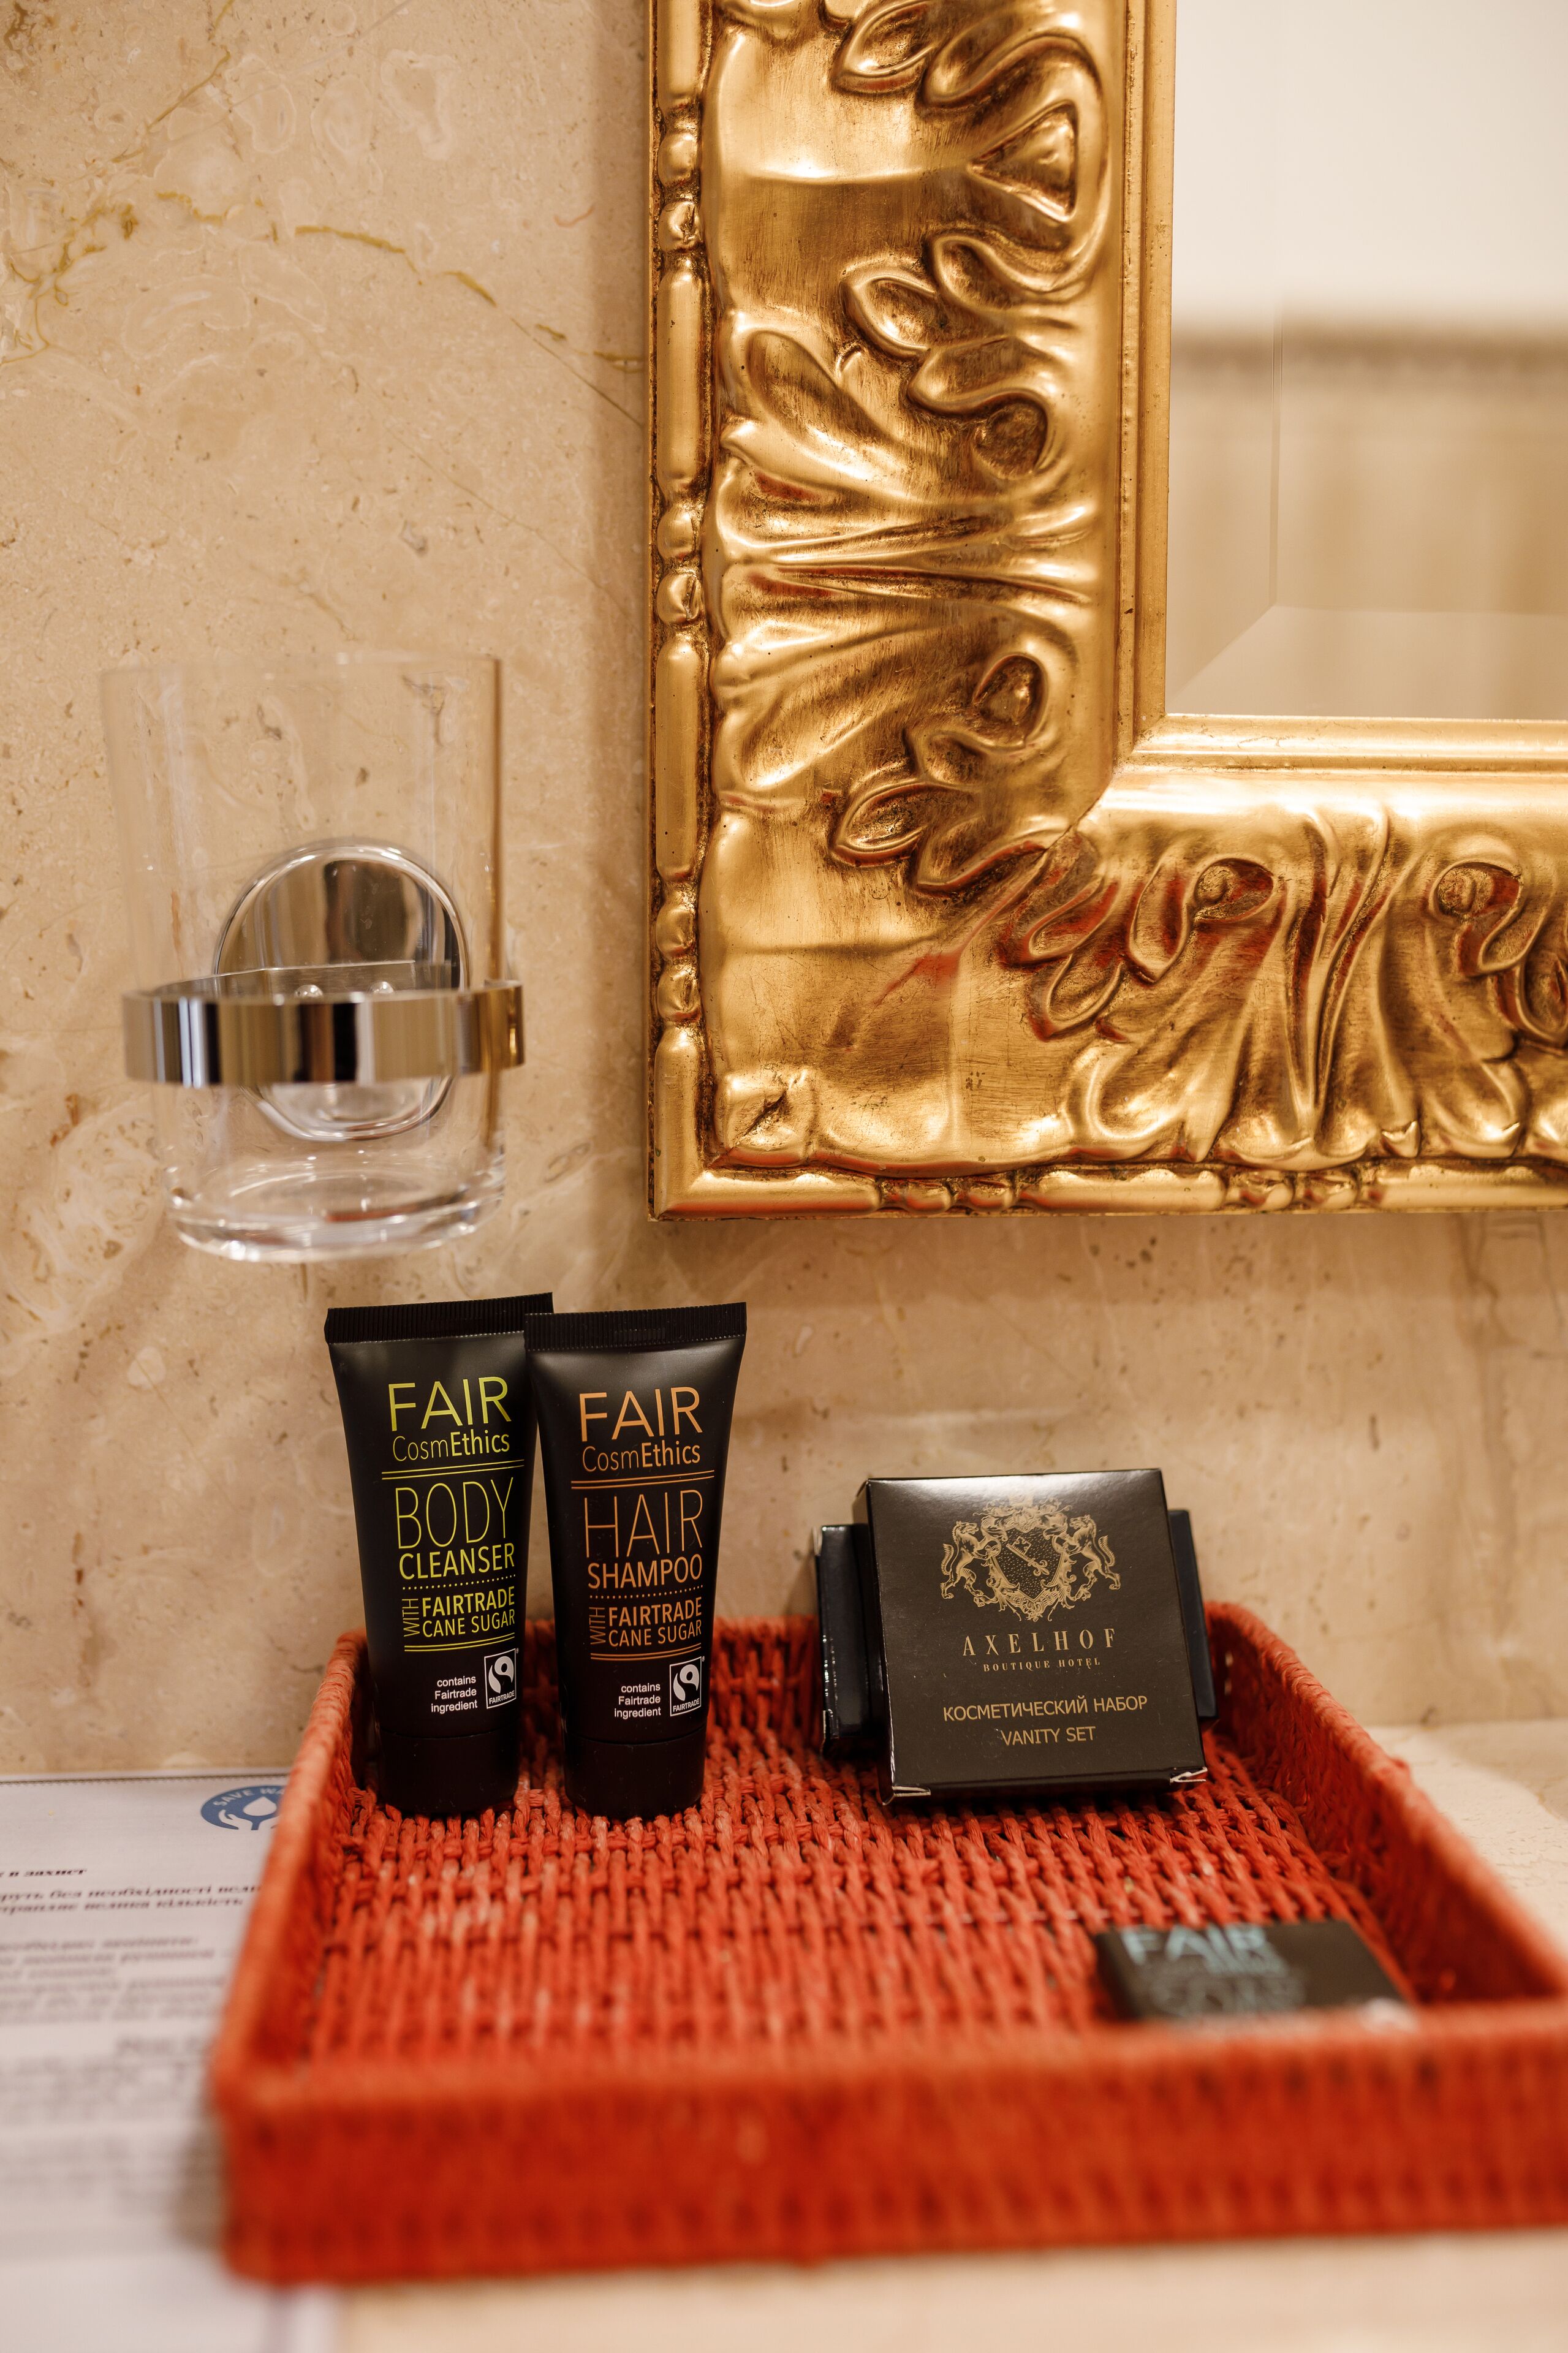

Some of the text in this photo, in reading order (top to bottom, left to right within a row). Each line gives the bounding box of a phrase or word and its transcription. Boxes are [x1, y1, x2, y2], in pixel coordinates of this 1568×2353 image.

[388, 1376, 512, 1431] FAIR
[580, 1387, 703, 1442] FAIR
[393, 1429, 510, 1461] CosmEthics
[583, 1440, 700, 1472] CosmEthics
[395, 1477, 513, 1549] BODY
[585, 1490, 703, 1558] HAIR
[400, 1542, 515, 1580] CLEANSER
[588, 1553, 702, 1589] SHAMPOO
[422, 1586, 515, 1617] FAIRTRADE
[608, 1596, 702, 1626] FAIRTRADE
[402, 1598, 420, 1637] WITH
[423, 1609, 515, 1637] CANE SUGAR
[589, 1607, 606, 1645] WITH
[608, 1620, 702, 1647] CANE SUGAR
[963, 1627, 1115, 1656] AXELHOF
[983, 1658, 1100, 1672] BOUTIQUE HOTEL
[434, 1688, 477, 1700] Fairtrade
[437, 1675, 476, 1687] contains
[621, 1683, 661, 1693] contains
[431, 1699, 478, 1714] ingredient
[488, 1690, 515, 1704] FAIRTRADE
[618, 1694, 661, 1705] Fairtrade
[673, 1698, 700, 1712] FAIRTRADE
[943, 1696, 1148, 1721] КОСМЕТИЧЕСКИЙ НАБОР
[614, 1707, 661, 1719] ingredient
[1001, 1726, 1096, 1746] VANITY SET
[213, 1789, 255, 1806] SAVE
